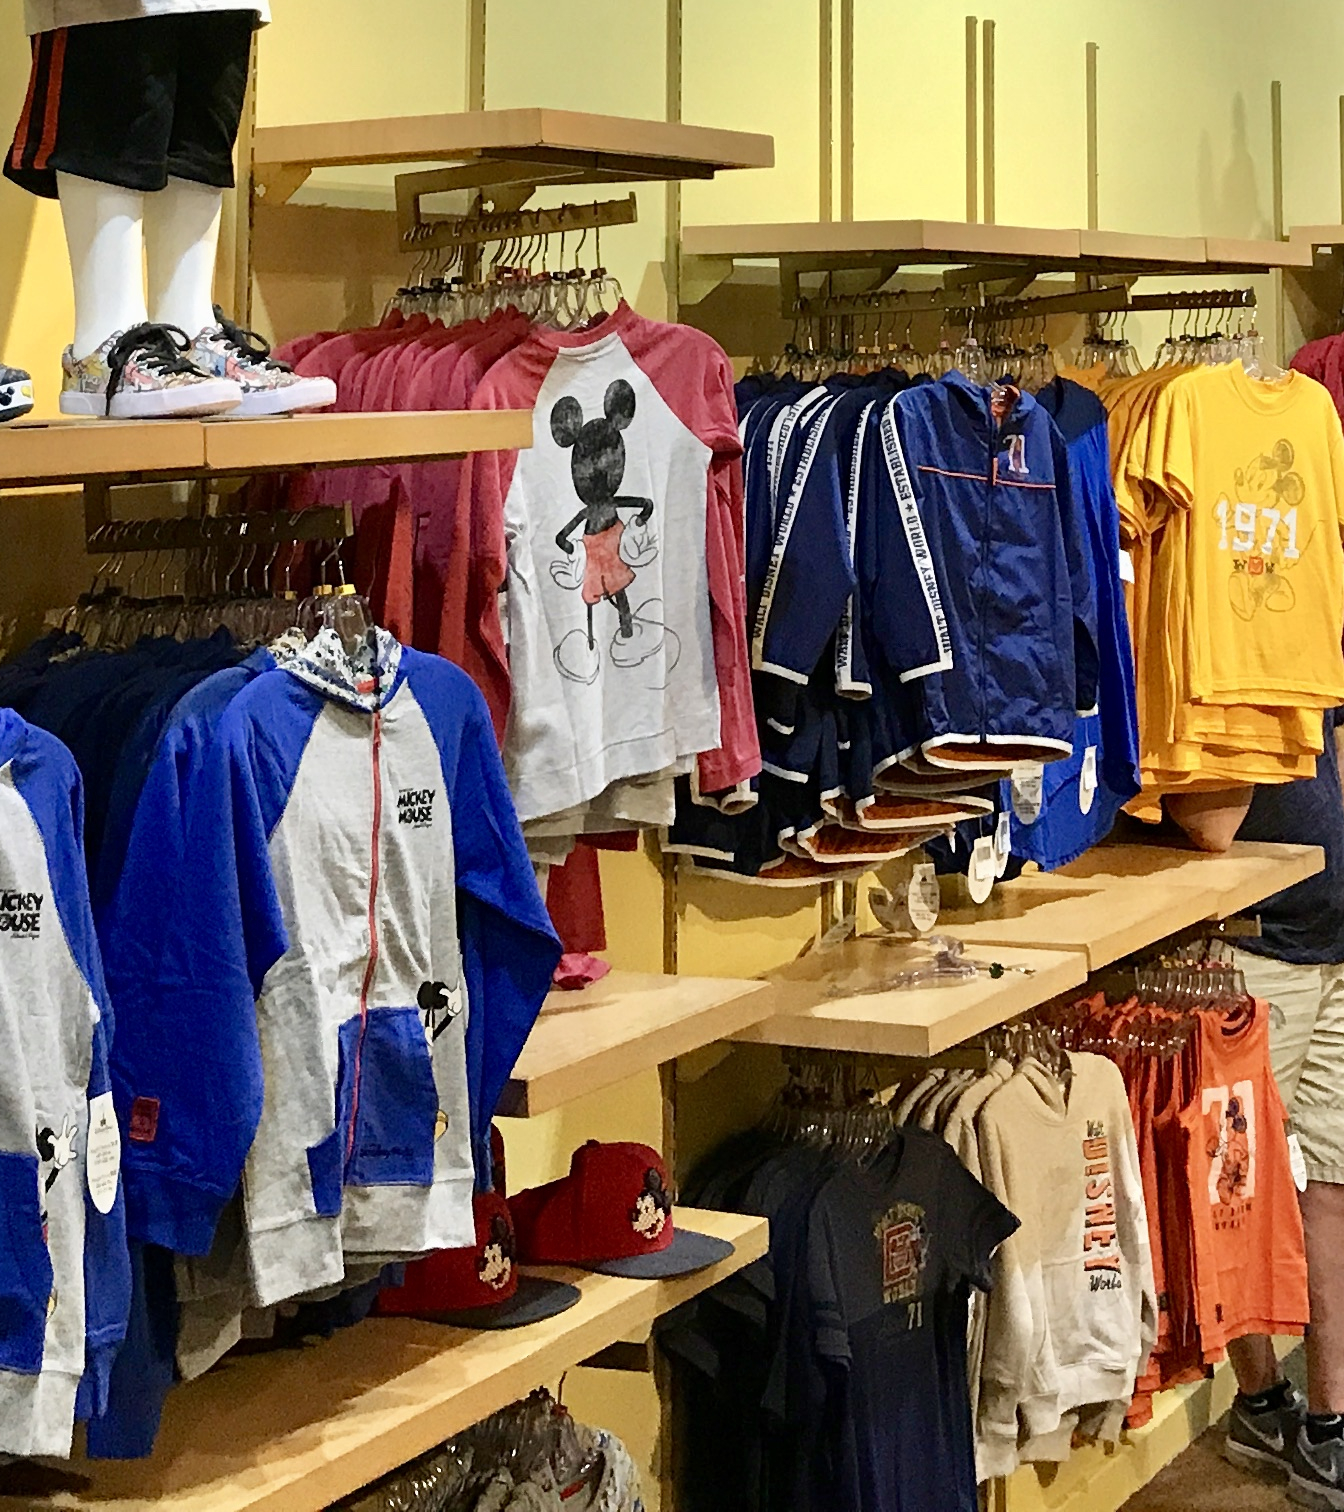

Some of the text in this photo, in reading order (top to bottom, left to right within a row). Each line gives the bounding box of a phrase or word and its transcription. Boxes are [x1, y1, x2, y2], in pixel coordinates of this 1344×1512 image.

[881, 418, 912, 501] ESTABLISHED
[1002, 434, 1030, 474] 71
[906, 515, 928, 559] WORLD
[1216, 500, 1300, 559] 1971
[397, 789, 436, 808] MICKEY
[398, 805, 433, 824] MOUSE
[1202, 1079, 1256, 1206] 71
[1082, 1136, 1122, 1275] DISNEY
